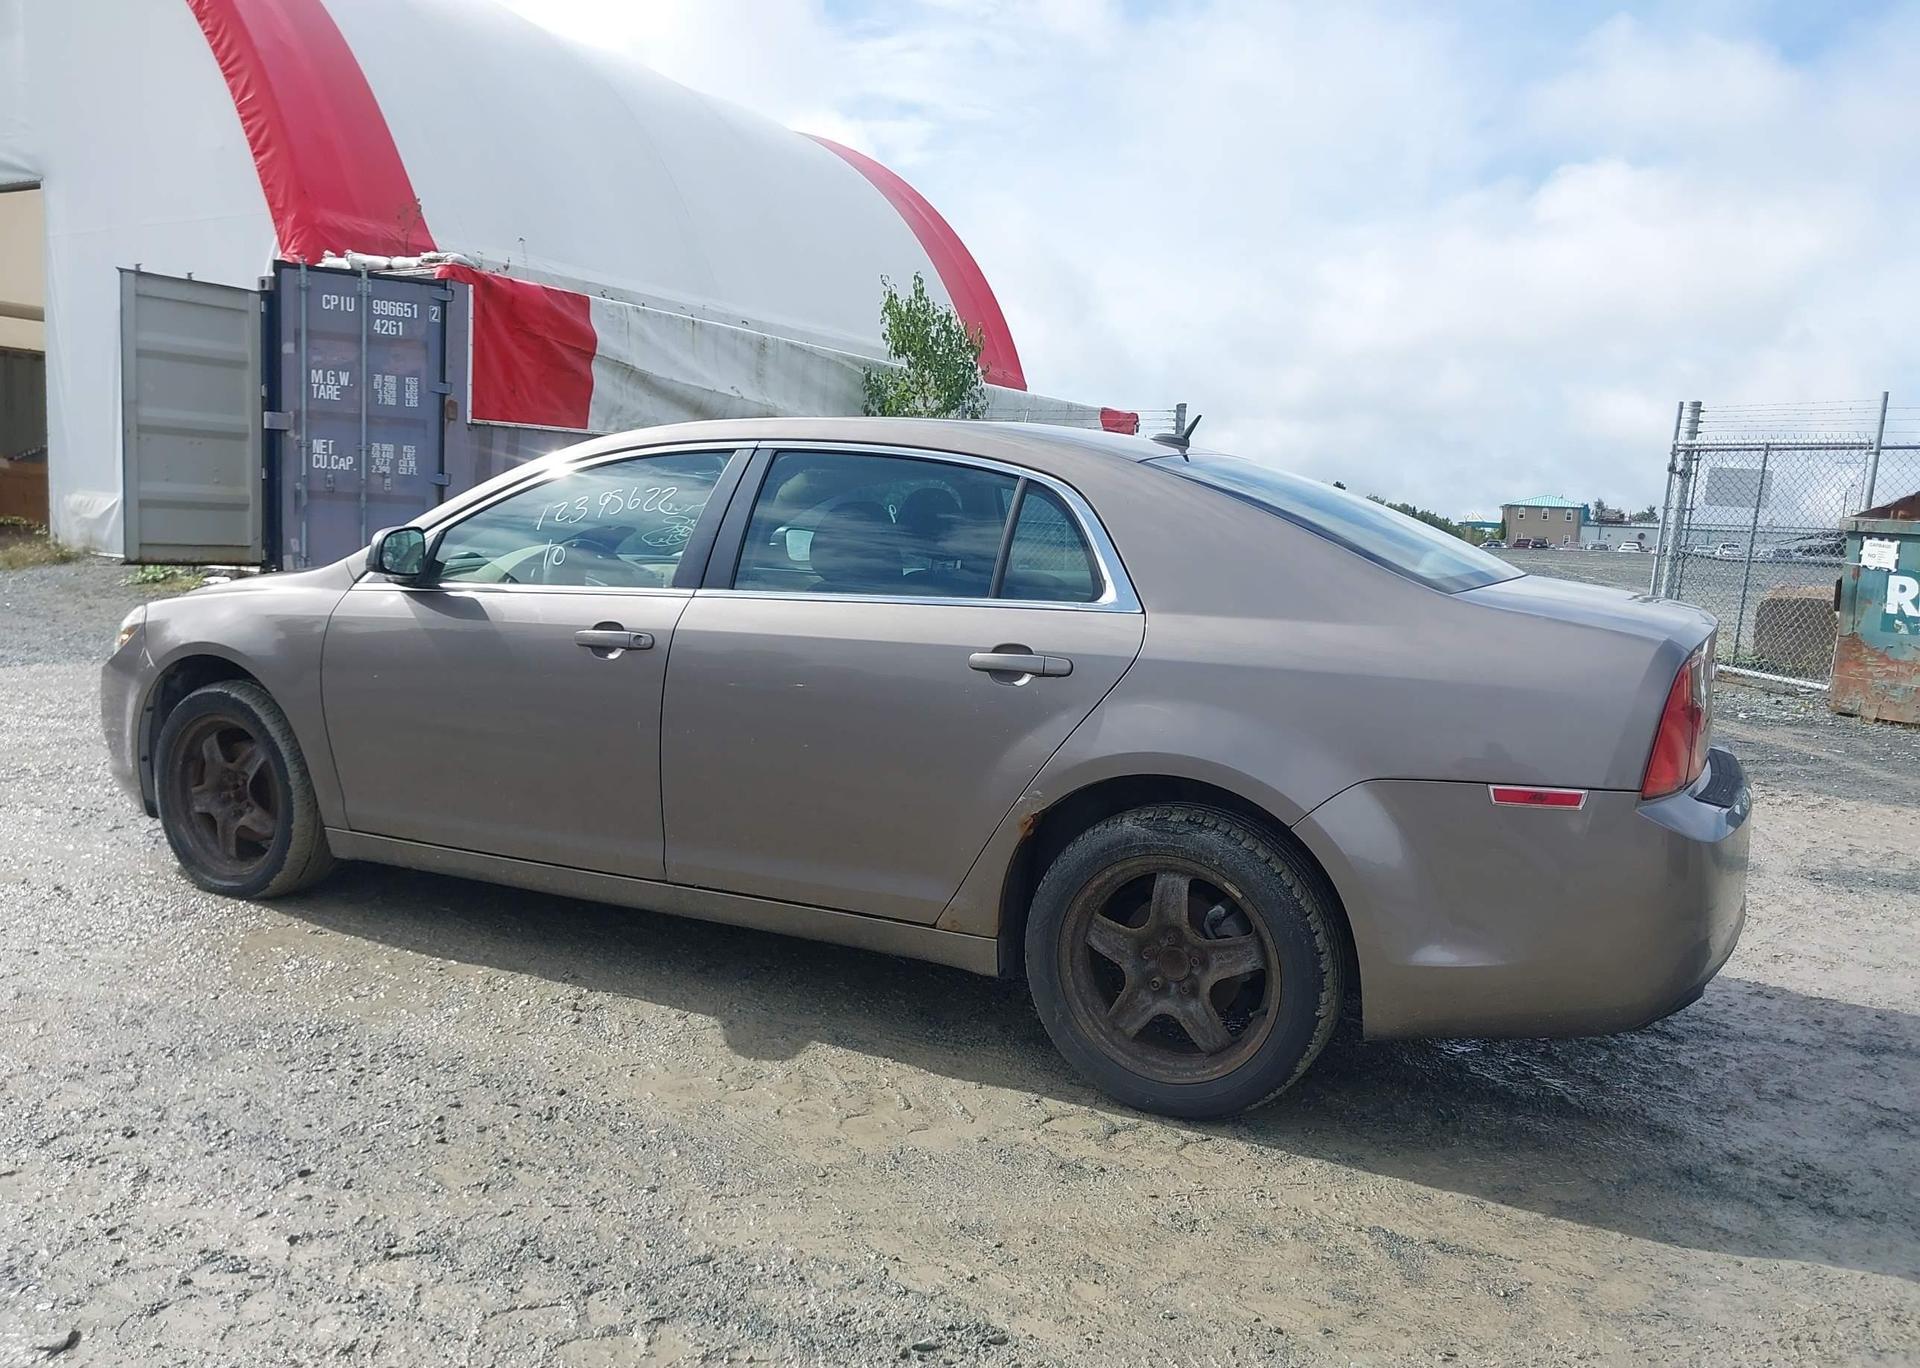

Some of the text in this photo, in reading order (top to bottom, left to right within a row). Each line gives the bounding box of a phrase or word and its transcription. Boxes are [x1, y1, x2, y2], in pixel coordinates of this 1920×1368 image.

[322, 294, 441, 322] CPIU 996651 2
[373, 319, 403, 336] 42G1
[311, 369, 354, 387] M.G.W.
[312, 384, 341, 401] TARE
[312, 439, 335, 454] NET
[1886, 575, 1920, 617] R
